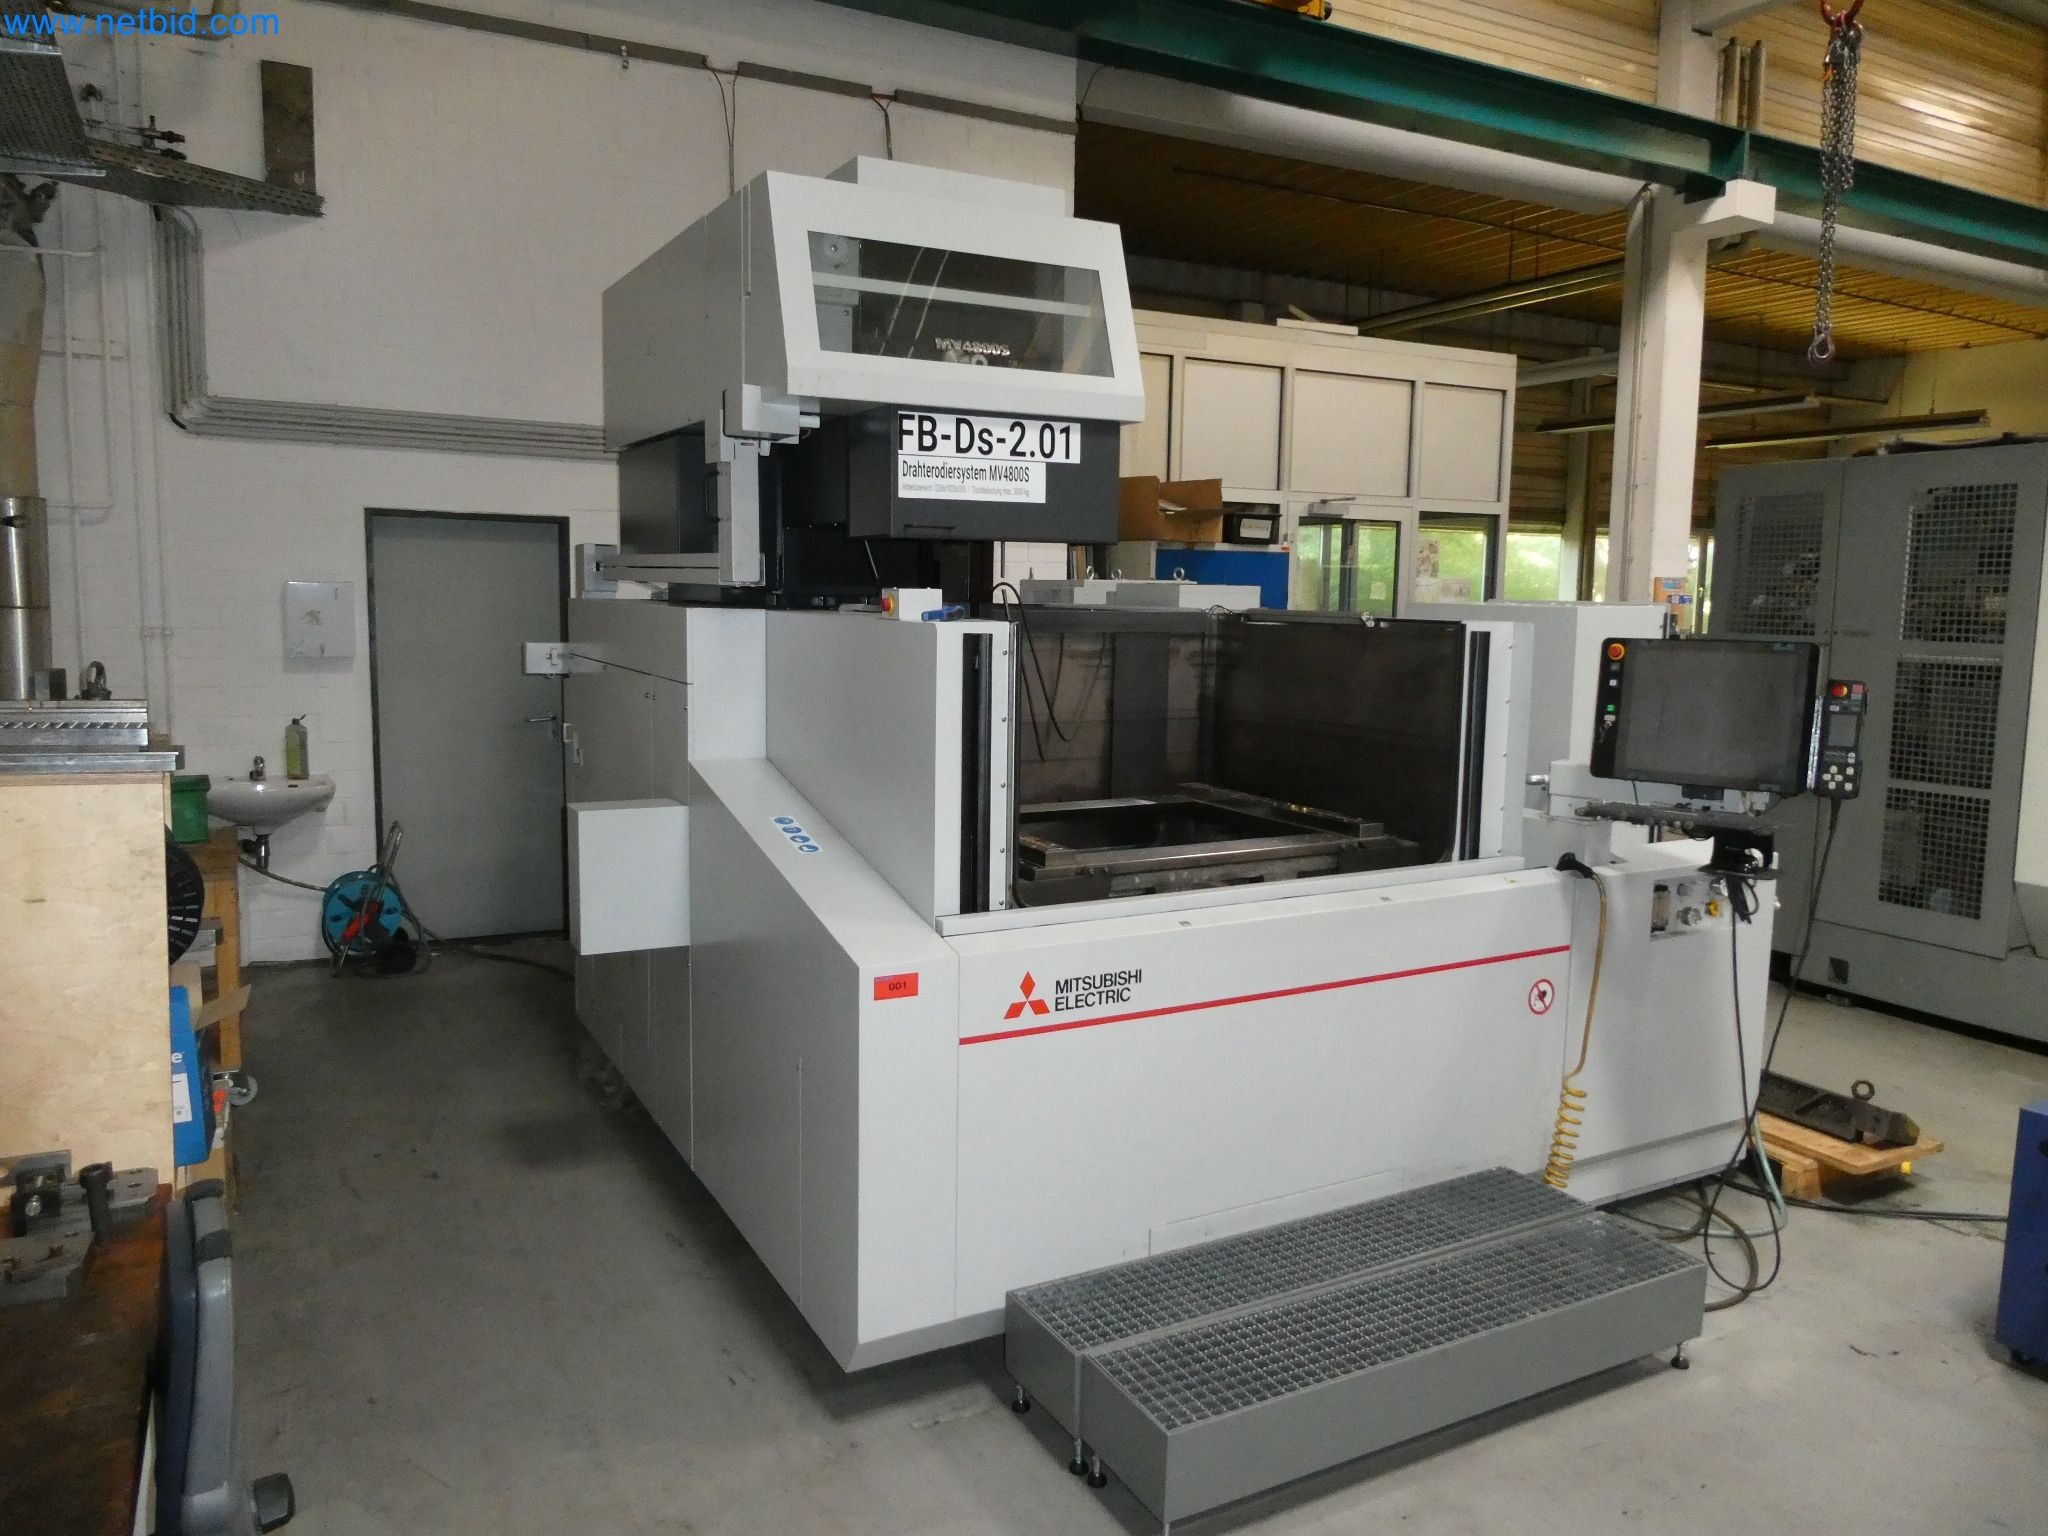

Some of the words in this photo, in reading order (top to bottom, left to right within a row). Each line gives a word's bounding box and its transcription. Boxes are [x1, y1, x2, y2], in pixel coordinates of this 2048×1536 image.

[898, 413, 1072, 460] FB-Ds-2.01
[902, 460, 987, 484] Drahterodiersystem
[989, 464, 1030, 483] MV4800S
[888, 981, 907, 991] 001
[1055, 968, 1142, 995] MITSUBISHI
[1054, 987, 1131, 1012] ELECTRIC
